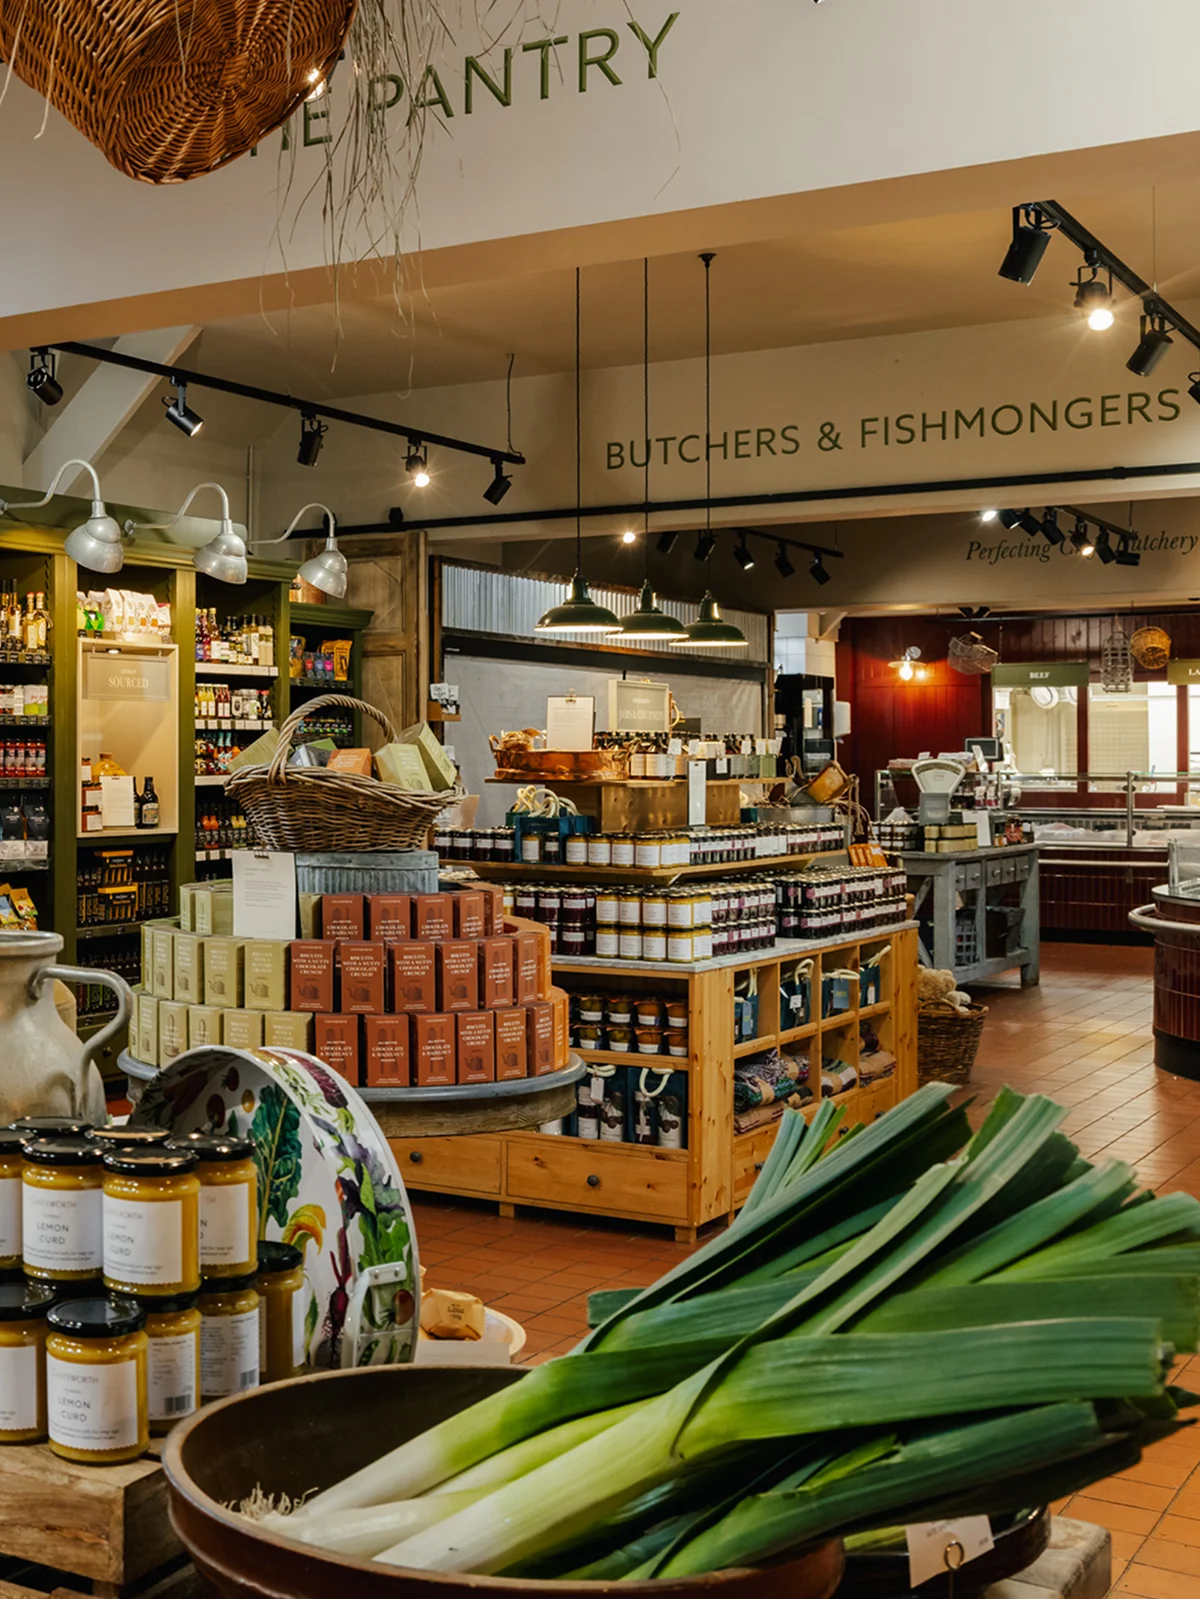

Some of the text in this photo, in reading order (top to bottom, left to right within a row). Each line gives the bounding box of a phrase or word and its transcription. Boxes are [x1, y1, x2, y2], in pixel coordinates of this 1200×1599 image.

[368, 11, 681, 134] PANTRY
[606, 388, 1182, 470] BUTCHERS & FISHMONGERS
[965, 538, 1051, 565] Perfecting
[108, 676, 149, 688] SOURCED
[1029, 671, 1051, 680] BEEF
[37, 1222, 69, 1233] LEMON
[39, 1236, 66, 1245] CURD
[108, 1231, 135, 1244] LEMON
[110, 1244, 131, 1257] CURD
[58, 1396, 91, 1409] LEMON
[61, 1409, 87, 1422] CURD
